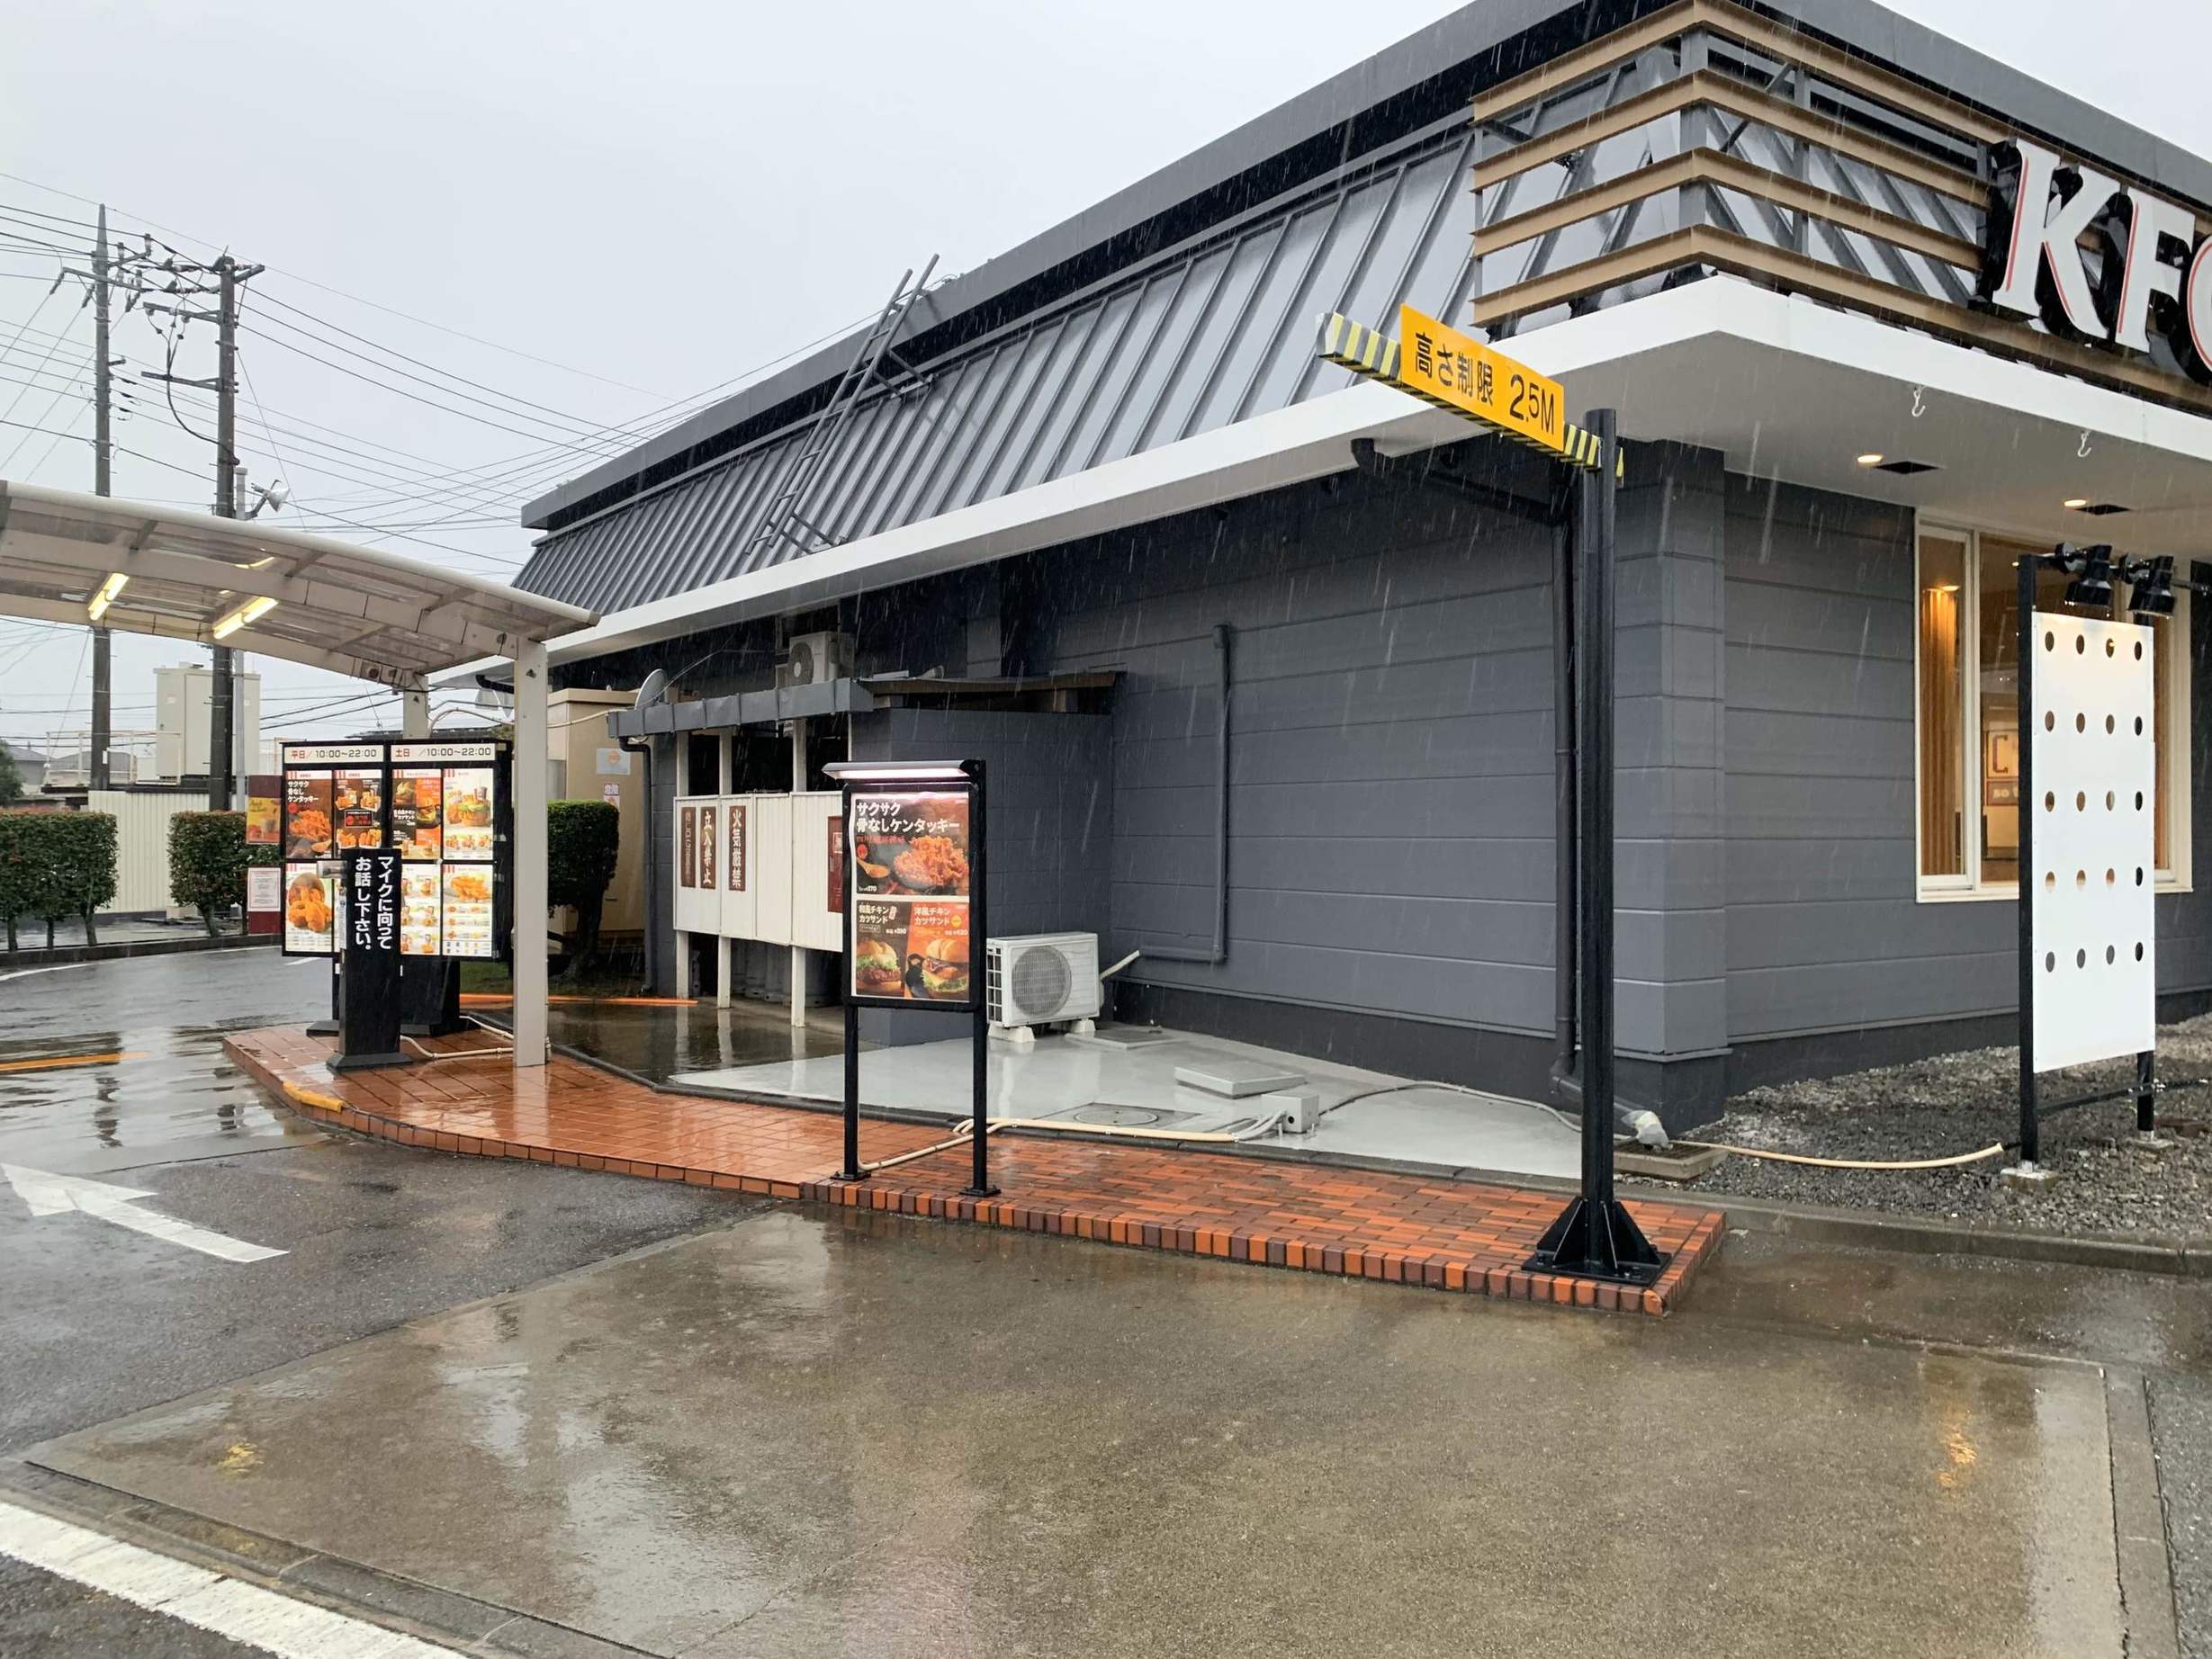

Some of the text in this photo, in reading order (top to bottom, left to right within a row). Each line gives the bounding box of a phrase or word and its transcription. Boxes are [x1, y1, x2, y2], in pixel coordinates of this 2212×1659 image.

[1415, 332, 1554, 435] 高さ制限 2.5M
[856, 818, 960, 832] 骨なしケンタッキー
[857, 802, 901, 816] サクサク
[703, 810, 712, 885] 立入禁止
[732, 809, 742, 888] 火気厳禁
[355, 856, 373, 950] お話し下さい。
[377, 856, 394, 949] マイクに向って
[859, 915, 888, 925] カツサンド
[914, 916, 950, 926] カツサンド
